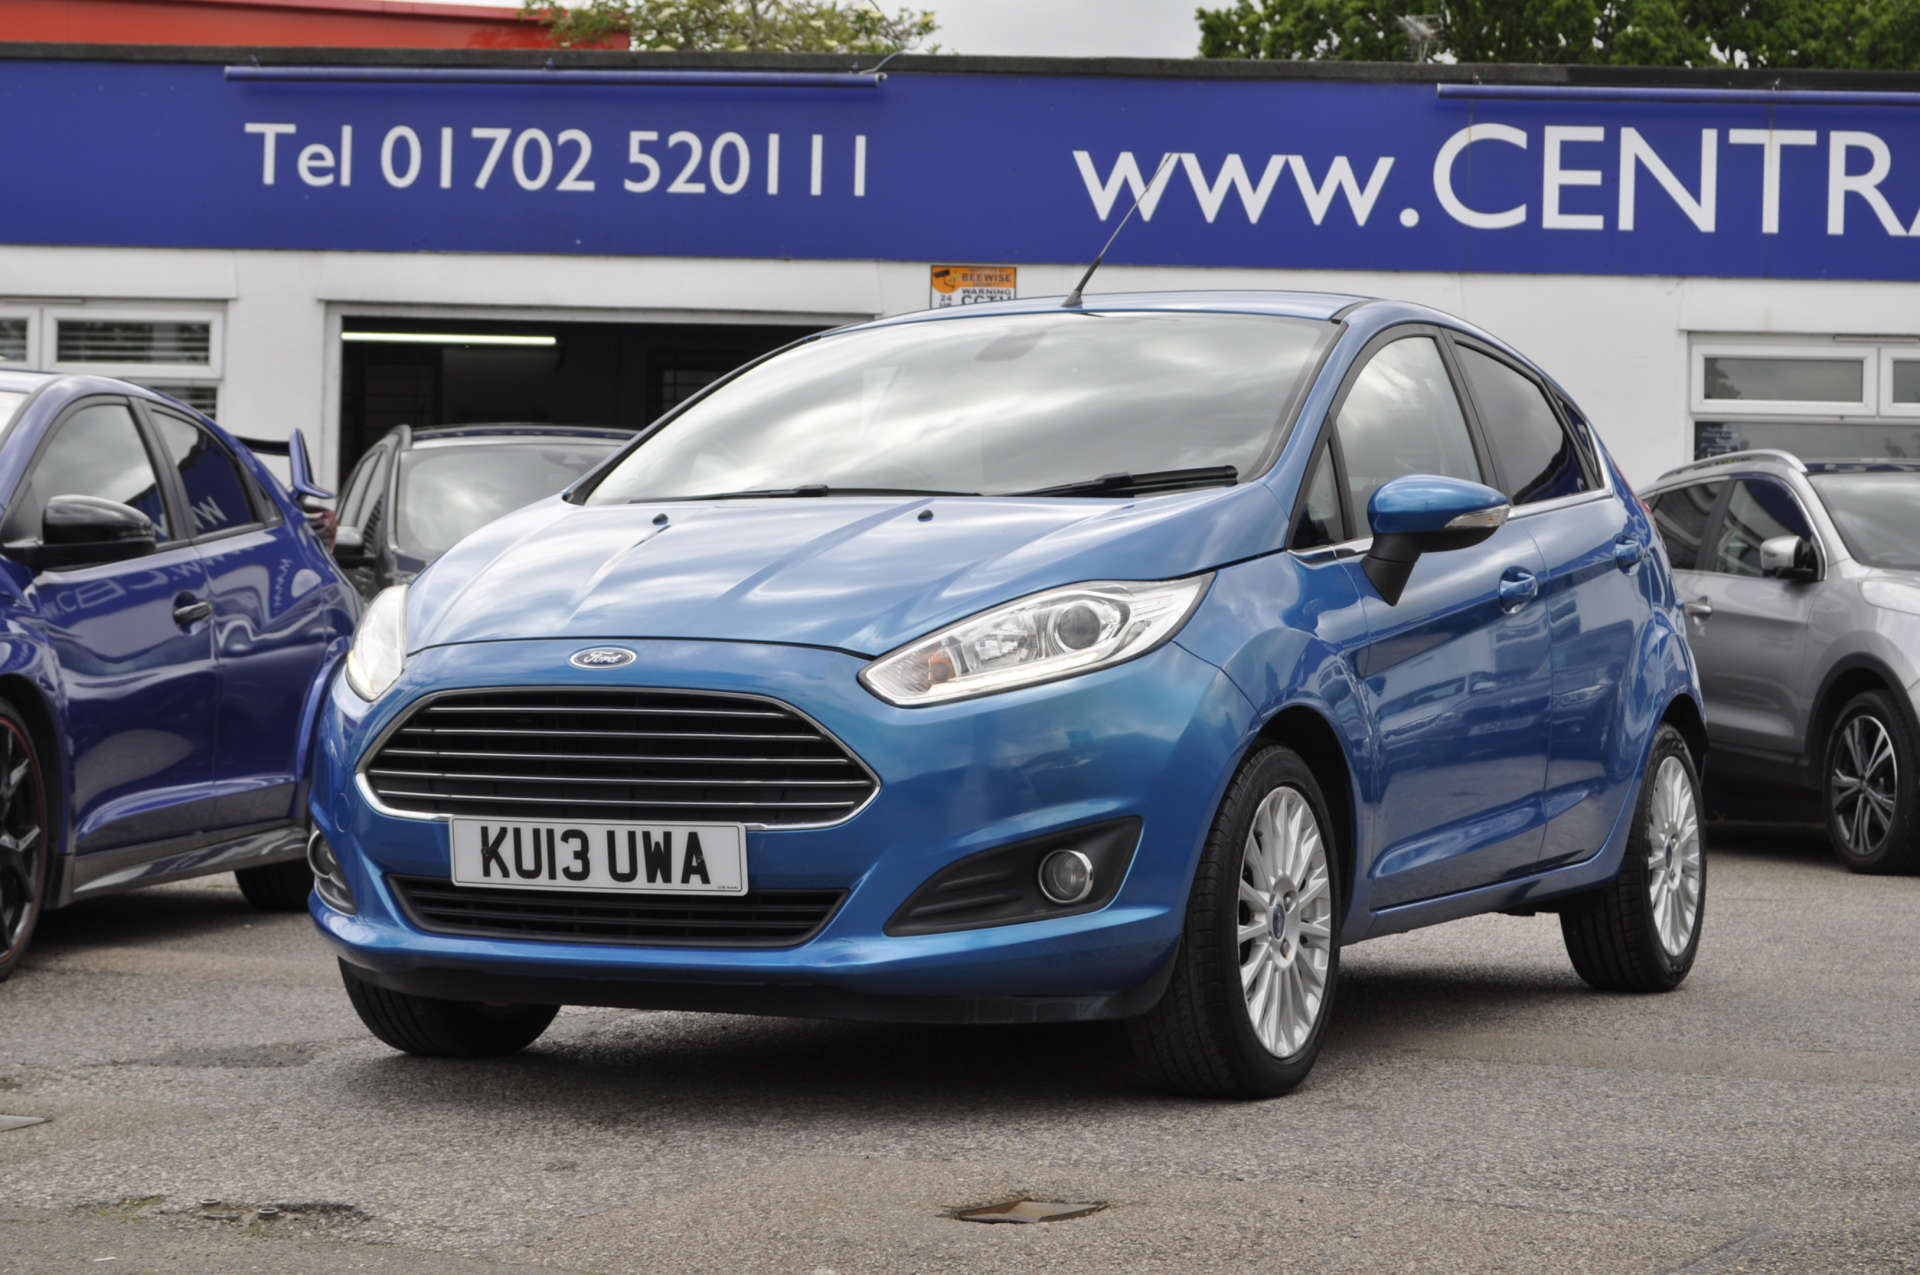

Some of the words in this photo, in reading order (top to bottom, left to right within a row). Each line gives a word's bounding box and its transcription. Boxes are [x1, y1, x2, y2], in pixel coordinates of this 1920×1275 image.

[244, 122, 353, 187] Tel
[380, 125, 596, 192] 01702
[623, 130, 867, 197] 520111
[1072, 122, 1920, 237] www.CENTR
[961, 287, 1012, 296] WARNING
[583, 650, 622, 664] Ford
[480, 825, 591, 882] KU13
[606, 830, 711, 885] UWA
